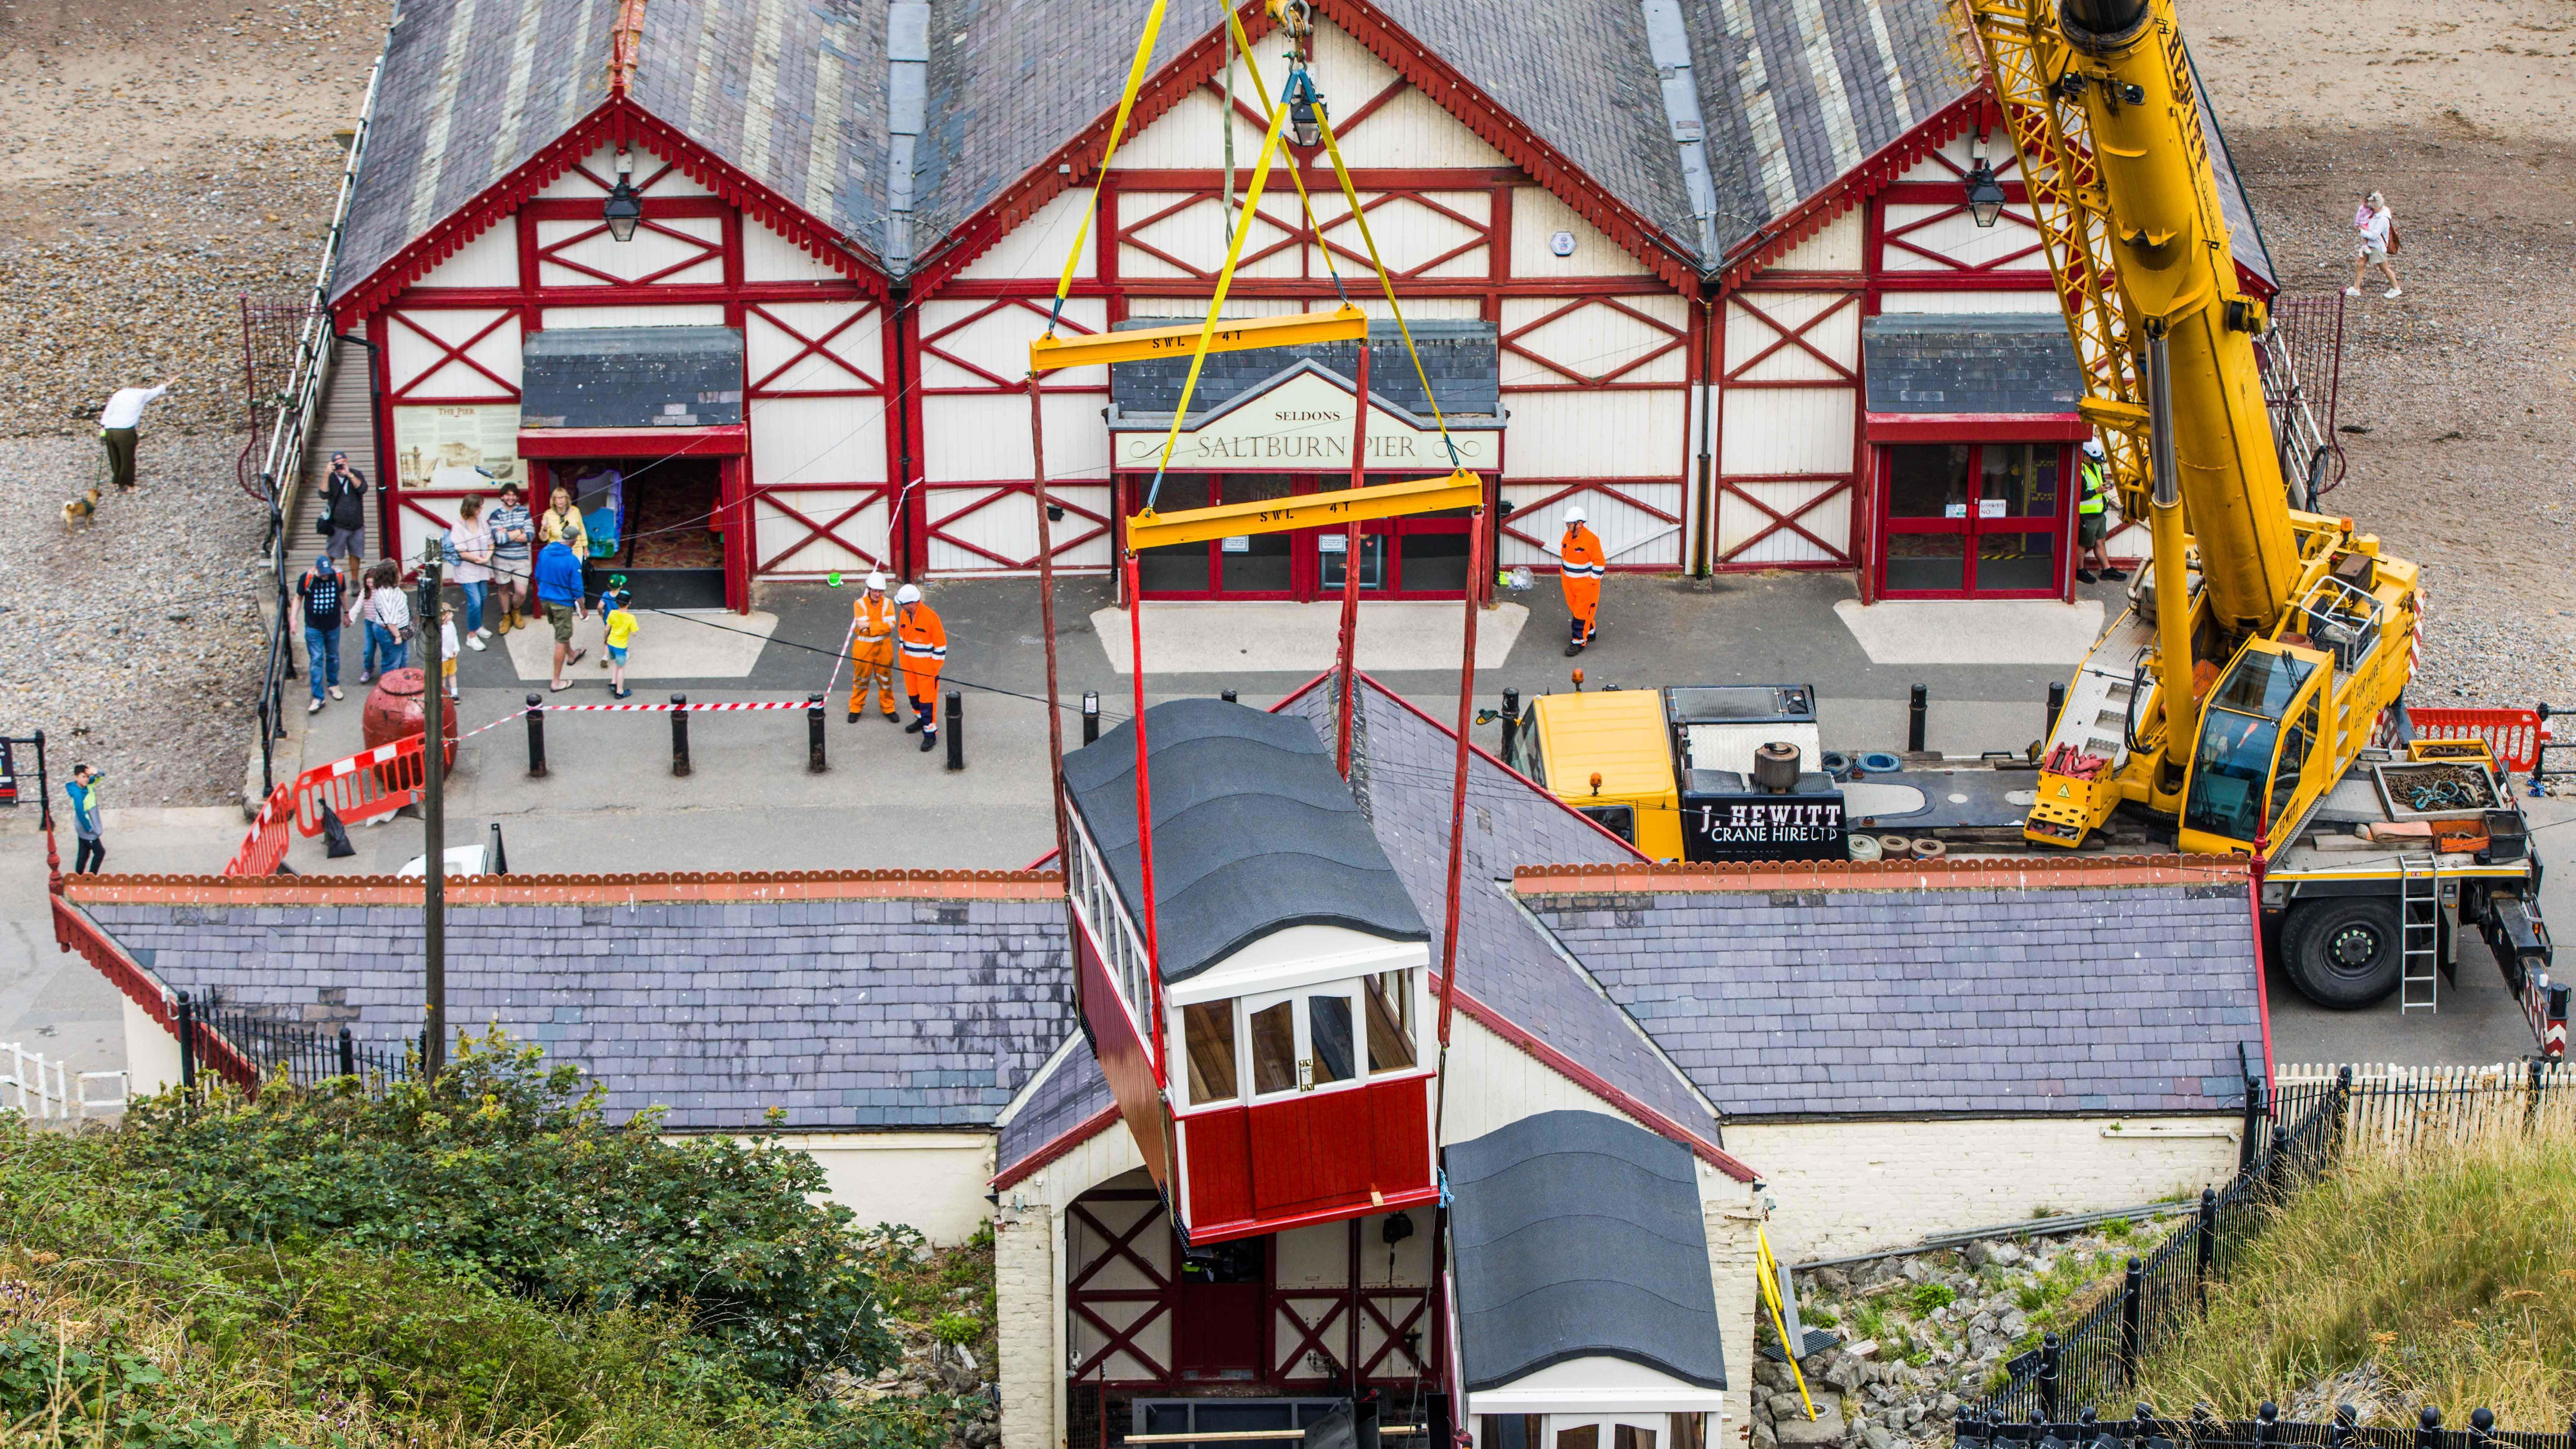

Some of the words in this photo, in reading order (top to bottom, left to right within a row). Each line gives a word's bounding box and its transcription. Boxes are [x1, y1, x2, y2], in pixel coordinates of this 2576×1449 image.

[1152, 336, 1185, 348] SWL
[1275, 411, 1340, 421] SELDONS
[1197, 436, 1346, 458] SALTBURN
[1260, 509, 1294, 522] SWL
[2356, 677, 2367, 701] FOR
[2367, 660, 2380, 688] HIRE
[1700, 806, 1721, 832] J.
[1729, 805, 1841, 827] HEWITT
[1711, 827, 1767, 842] CRANE
[1772, 827, 1809, 842] HIRE
[1811, 827, 1837, 842] LTD
